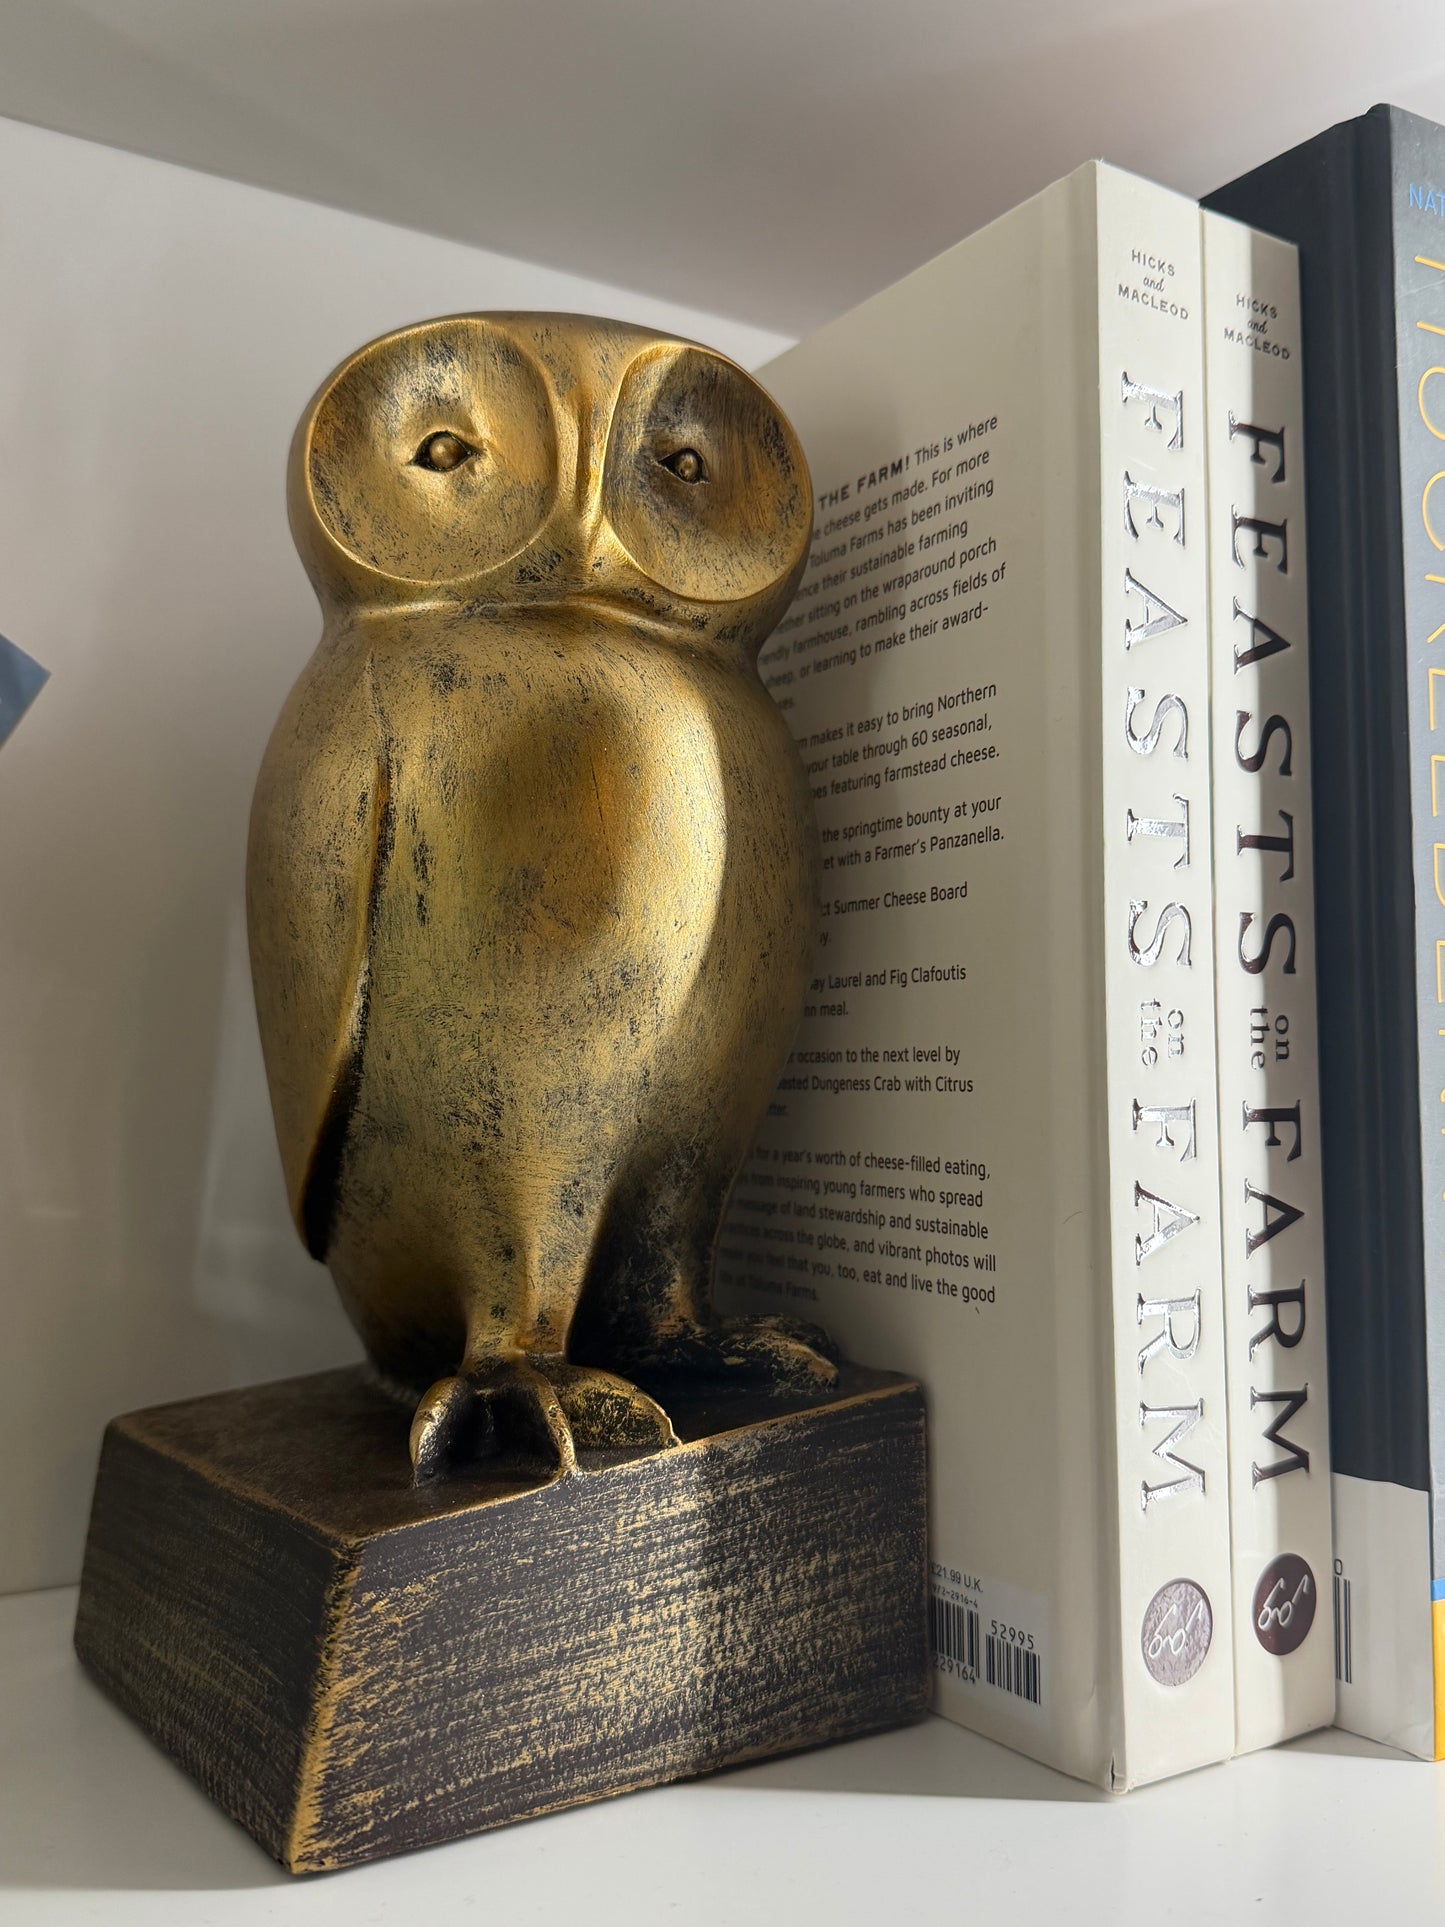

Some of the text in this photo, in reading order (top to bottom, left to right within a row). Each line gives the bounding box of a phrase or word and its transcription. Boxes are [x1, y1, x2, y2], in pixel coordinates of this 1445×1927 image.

[1132, 250, 1175, 276] HICKS
[1118, 284, 1188, 320] MACLEOD
[1143, 276, 1164, 292] and
[1236, 294, 1277, 319] HICKS
[1224, 327, 1290, 360] MACLEOD
[1248, 320, 1267, 334] and
[819, 415, 998, 510] THE FARM! This is where
[824, 511, 860, 539] cheese
[864, 497, 888, 521] gets
[892, 482, 928, 505] made.
[932, 470, 952, 486] For
[956, 450, 990, 476] more
[851, 528, 883, 552] Farms
[887, 519, 907, 536] has
[912, 502, 941, 525] been
[945, 480, 994, 511] inviting
[822, 569, 847, 592] their
[851, 542, 914, 577] sustainable
[919, 521, 968, 549] farming
[808, 599, 840, 623] sitting
[844, 594, 857, 609] on
[861, 582, 879, 602] the
[883, 553, 955, 592] wraparound
[960, 538, 996, 568] porch
[855, 604, 905, 632] rambling
[910, 586, 948, 611] across
[953, 574, 987, 597] fields
[991, 563, 1005, 583] of
[800, 664, 811, 678] or
[813, 645, 855, 674] learning
[860, 643, 872, 658] to
[875, 632, 905, 653] make
[910, 619, 938, 643] their
[943, 600, 989, 630] award-
[810, 726, 843, 747] makes
[847, 721, 854, 736] it
[858, 713, 883, 733] easy
[887, 711, 899, 724] to
[902, 700, 933, 721] bring
[937, 683, 997, 712] Northern
[807, 755, 829, 776] your
[832, 743, 859, 767] table
[862, 735, 907, 760] through
[912, 731, 928, 747] 60
[932, 713, 992, 742] seasonal,
[831, 770, 880, 796] featuring
[885, 753, 946, 783] farmstead
[951, 745, 1000, 768] cheese.
[822, 795, 1001, 843] the springtime bounty at your
[837, 849, 861, 867] with
[865, 849, 871, 863] a
[875, 837, 926, 861] Farmer's
[930, 824, 1004, 852] Panzanella.
[834, 896, 880, 914] Summer
[884, 885, 926, 908] Cheese
[930, 881, 968, 902] Board
[1121, 371, 1205, 1514] FEASTS on the FARM
[1228, 410, 1310, 1490] FEASTS on the FARM
[829, 971, 862, 989] Laurel
[865, 970, 886, 986] and
[890, 969, 907, 987] Fig
[911, 964, 966, 983] Clafoutis
[820, 1001, 848, 1017] meal.
[797, 1049, 842, 1063] occasion
[846, 1049, 857, 1062] to
[861, 1047, 879, 1062] the
[883, 1047, 909, 1062] next
[913, 1046, 941, 1062] level
[945, 1046, 960, 1065] by
[811, 1076, 870, 1094] Dungeness
[874, 1076, 900, 1091] Crab
[905, 1076, 931, 1091] with
[935, 1075, 973, 1093] Citrus
[815, 1151, 846, 1166] worth
[849, 1151, 861, 1166] of
[864, 1152, 941, 1173] cheese-filled
[944, 1157, 991, 1180] eating,
[777, 1176, 820, 1194] inspiring
[824, 1180, 856, 1198] young
[860, 1180, 905, 1200] farmers
[909, 1185, 935, 1202] who
[939, 1190, 983, 1208] spread
[794, 1202, 815, 1218] land
[819, 1204, 885, 1230] stewardship
[889, 1214, 911, 1231] and
[916, 1216, 988, 1239] sustainable
[797, 1230, 813, 1244] the
[817, 1232, 849, 1251] globe,
[853, 1239, 874, 1254] and
[879, 1241, 921, 1262] vibrant
[926, 1250, 969, 1268] photos
[974, 1254, 996, 1271] will
[812, 1259, 834, 1277] you,
[838, 1264, 859, 1282] too,
[863, 1269, 882, 1284] eat
[886, 1272, 907, 1288] and
[911, 1274, 932, 1292] live
[937, 1278, 957, 1296] the
[962, 1286, 995, 1303] good
[964, 1574, 983, 1592] U.K.
[991, 1620, 1034, 1649] 52995
